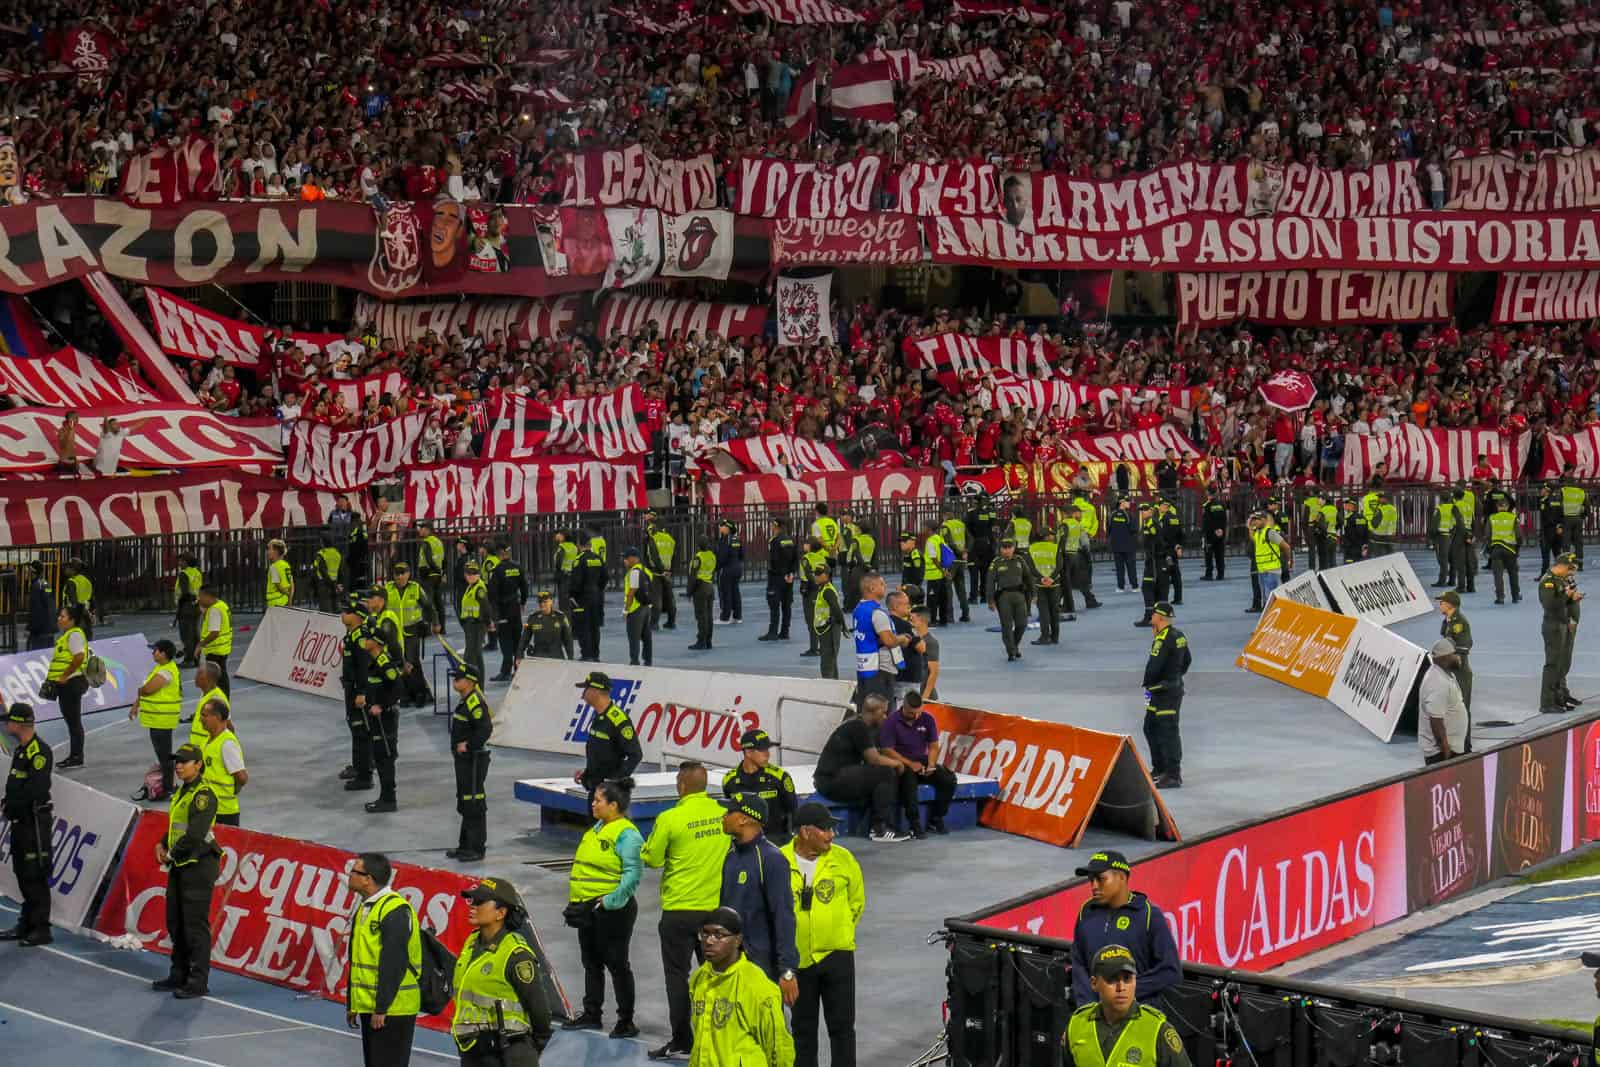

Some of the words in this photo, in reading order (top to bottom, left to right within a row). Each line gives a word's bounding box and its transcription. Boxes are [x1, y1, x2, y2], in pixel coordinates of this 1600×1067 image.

[1037, 162, 1242, 231] ARMENIA
[1162, 217, 1341, 263] PASION
[1355, 218, 1600, 264] HISTORIA
[1181, 272, 1310, 323] PUERTO
[1316, 271, 1449, 321] TEJADA
[1215, 830, 1376, 967] CALDAS
